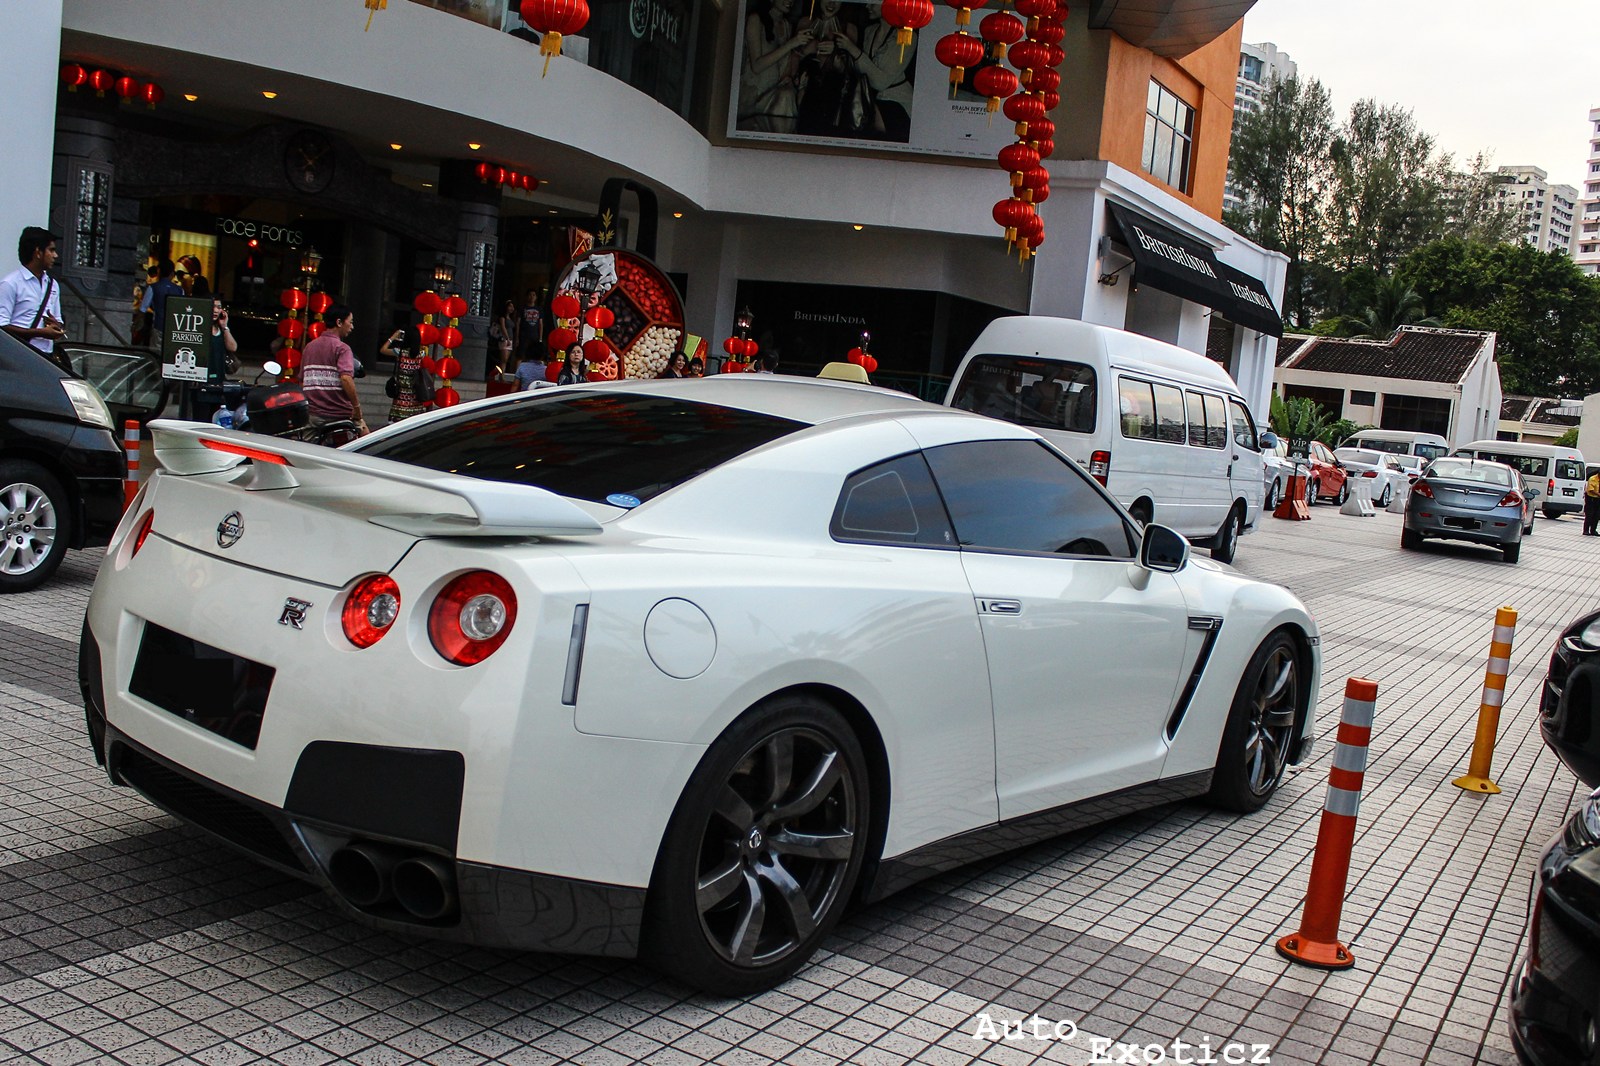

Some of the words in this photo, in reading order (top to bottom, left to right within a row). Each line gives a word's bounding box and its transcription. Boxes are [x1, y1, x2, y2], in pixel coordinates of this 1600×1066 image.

[629, 0, 678, 43] Opera
[216, 217, 256, 237] Face
[1227, 280, 1274, 311] TISHINDIA
[173, 313, 204, 332] VIP
[171, 332, 203, 343] PARKING
[1292, 439, 1307, 447] VIP
